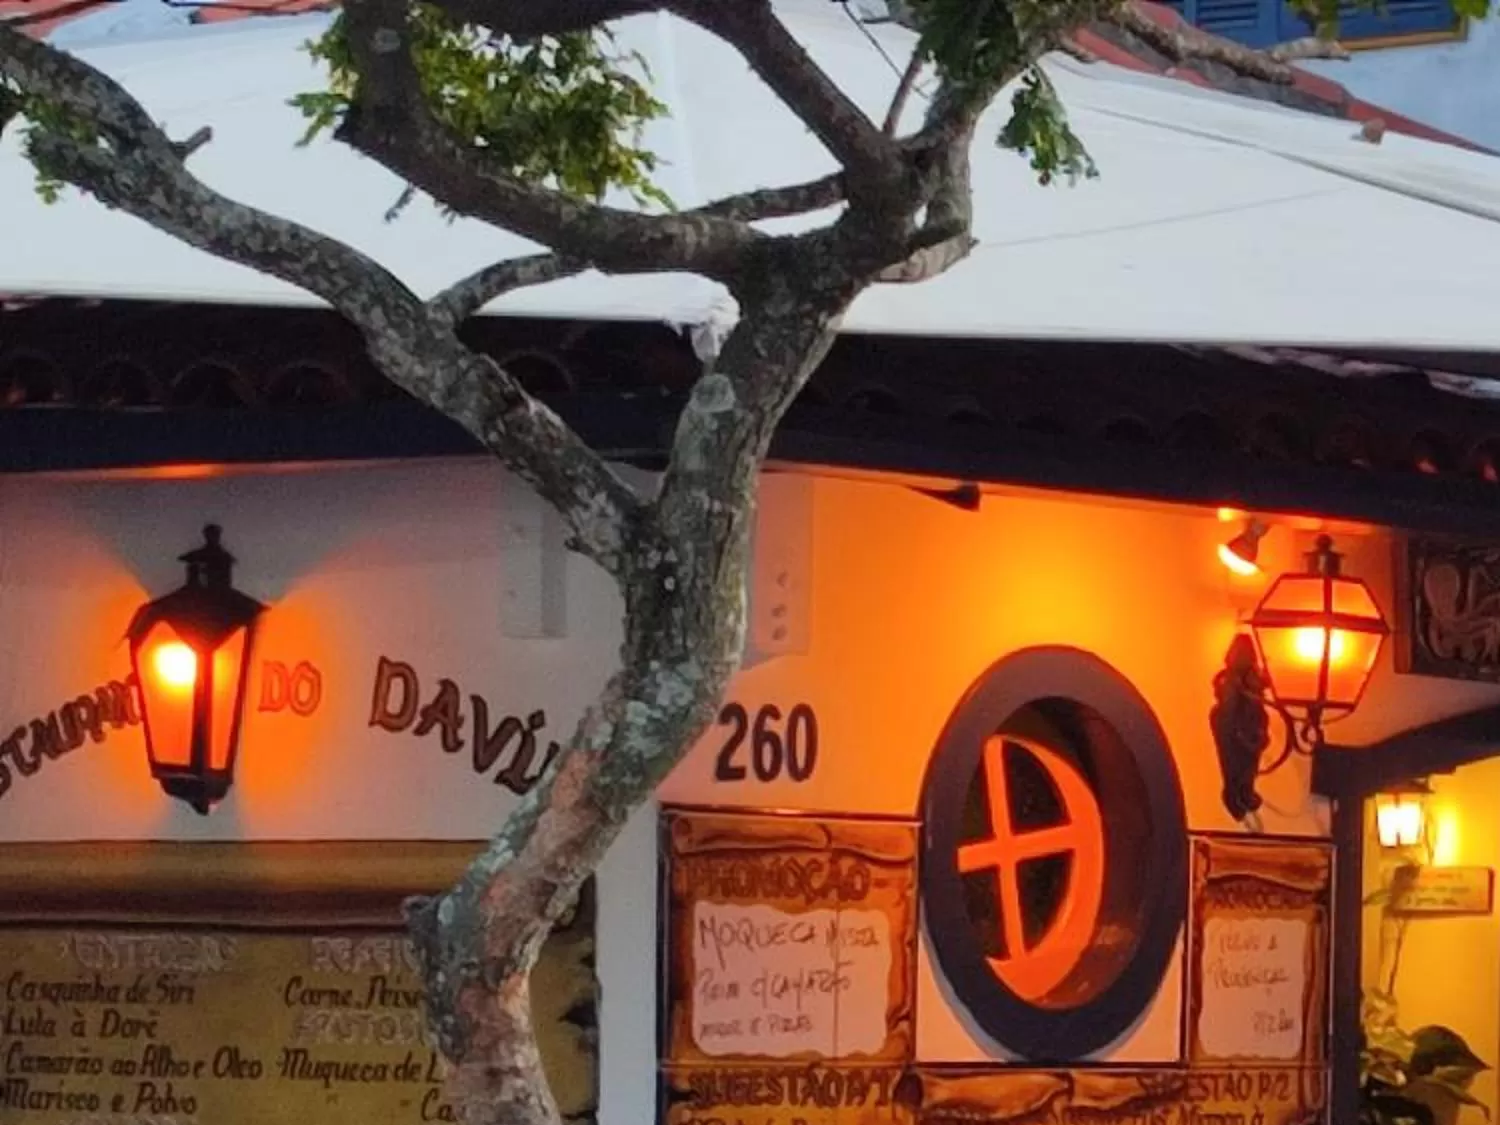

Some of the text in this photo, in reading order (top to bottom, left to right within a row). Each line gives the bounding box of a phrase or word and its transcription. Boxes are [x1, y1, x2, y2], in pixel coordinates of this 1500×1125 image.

[258, 659, 323, 718] DO
[713, 701, 818, 784] 260
[4, 1008, 57, 1038] Lula
[6, 1042, 104, 1077] Camarão
[393, 1051, 422, 1083] de
[1, 1077, 101, 1112] Marisco
